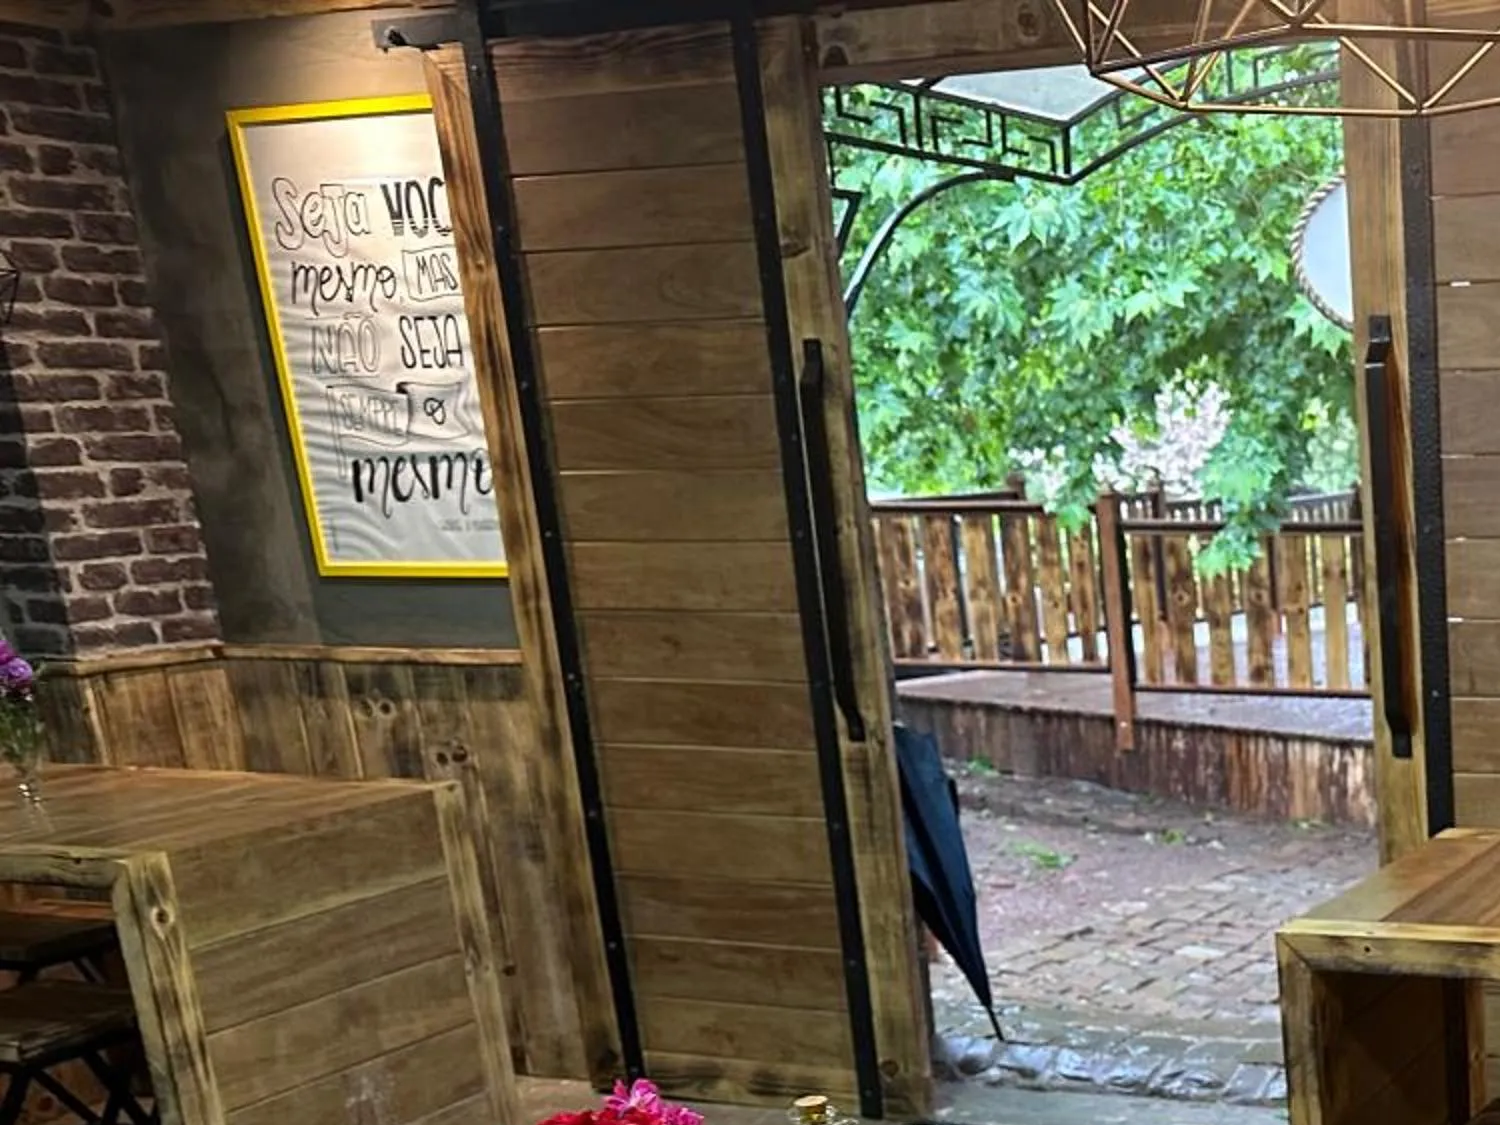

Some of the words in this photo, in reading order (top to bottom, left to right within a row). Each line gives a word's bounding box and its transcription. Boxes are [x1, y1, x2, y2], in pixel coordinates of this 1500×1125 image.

[380, 177, 452, 238] VOC
[291, 260, 397, 316] mesmo
[414, 252, 458, 295] MAS
[311, 311, 380, 375] NÃO
[399, 313, 464, 370] SEJA
[352, 447, 493, 519] mesmo
